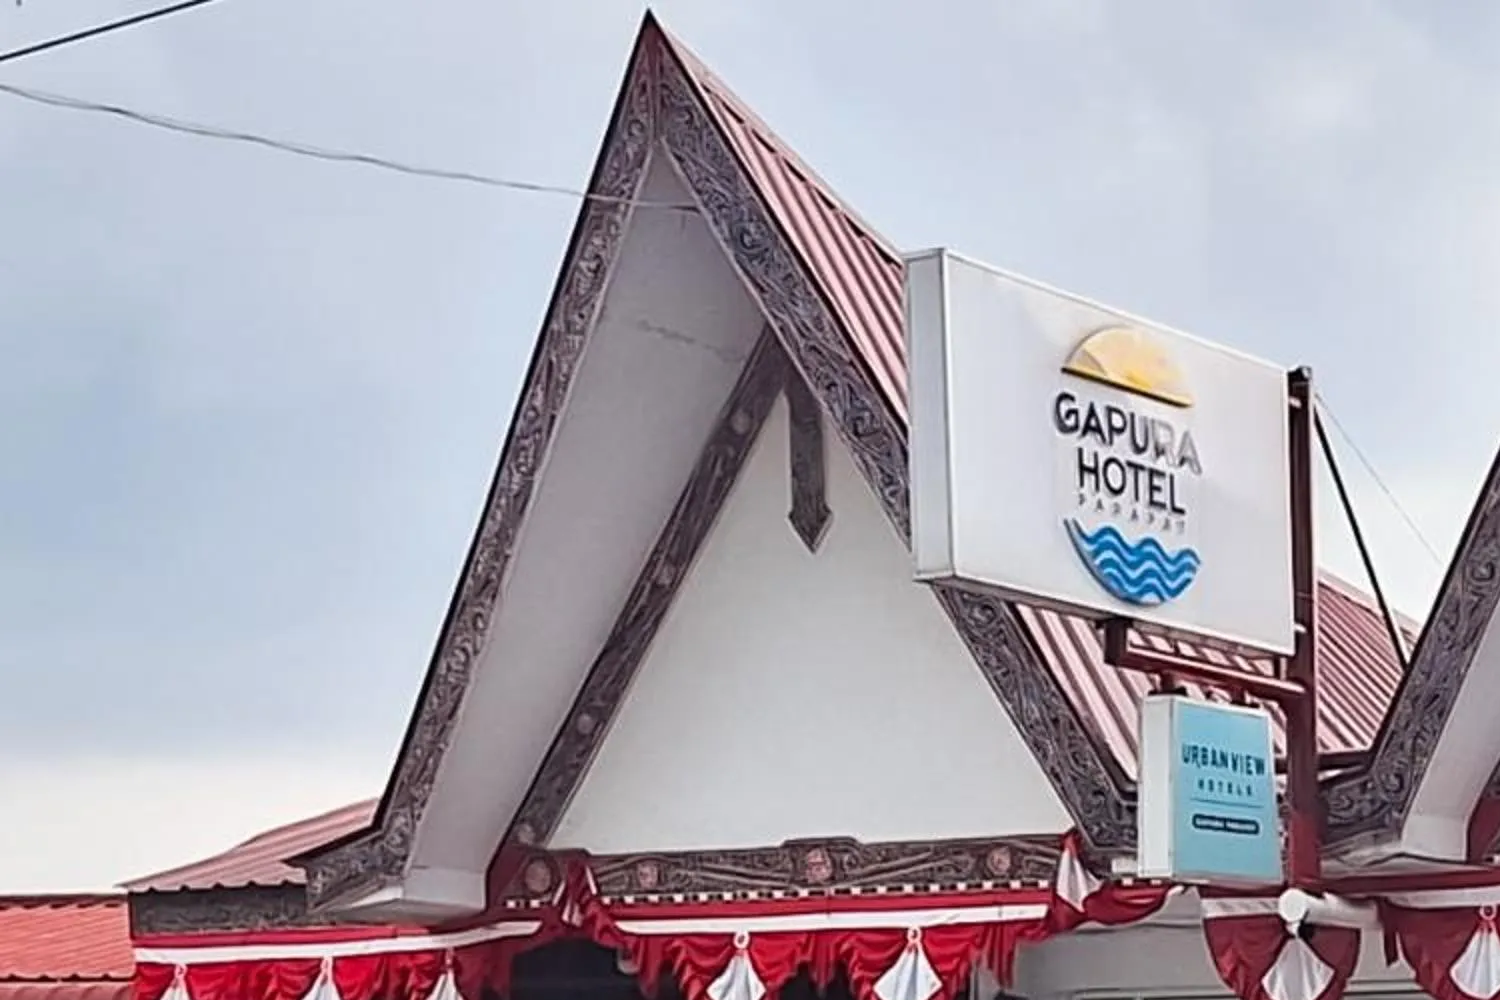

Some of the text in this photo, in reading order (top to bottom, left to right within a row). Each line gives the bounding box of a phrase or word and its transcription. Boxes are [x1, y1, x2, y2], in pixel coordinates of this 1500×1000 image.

[1054, 392, 1202, 475] GAPURA
[1076, 447, 1186, 516] HOTEL
[1182, 744, 1265, 775] URBANVIEW
